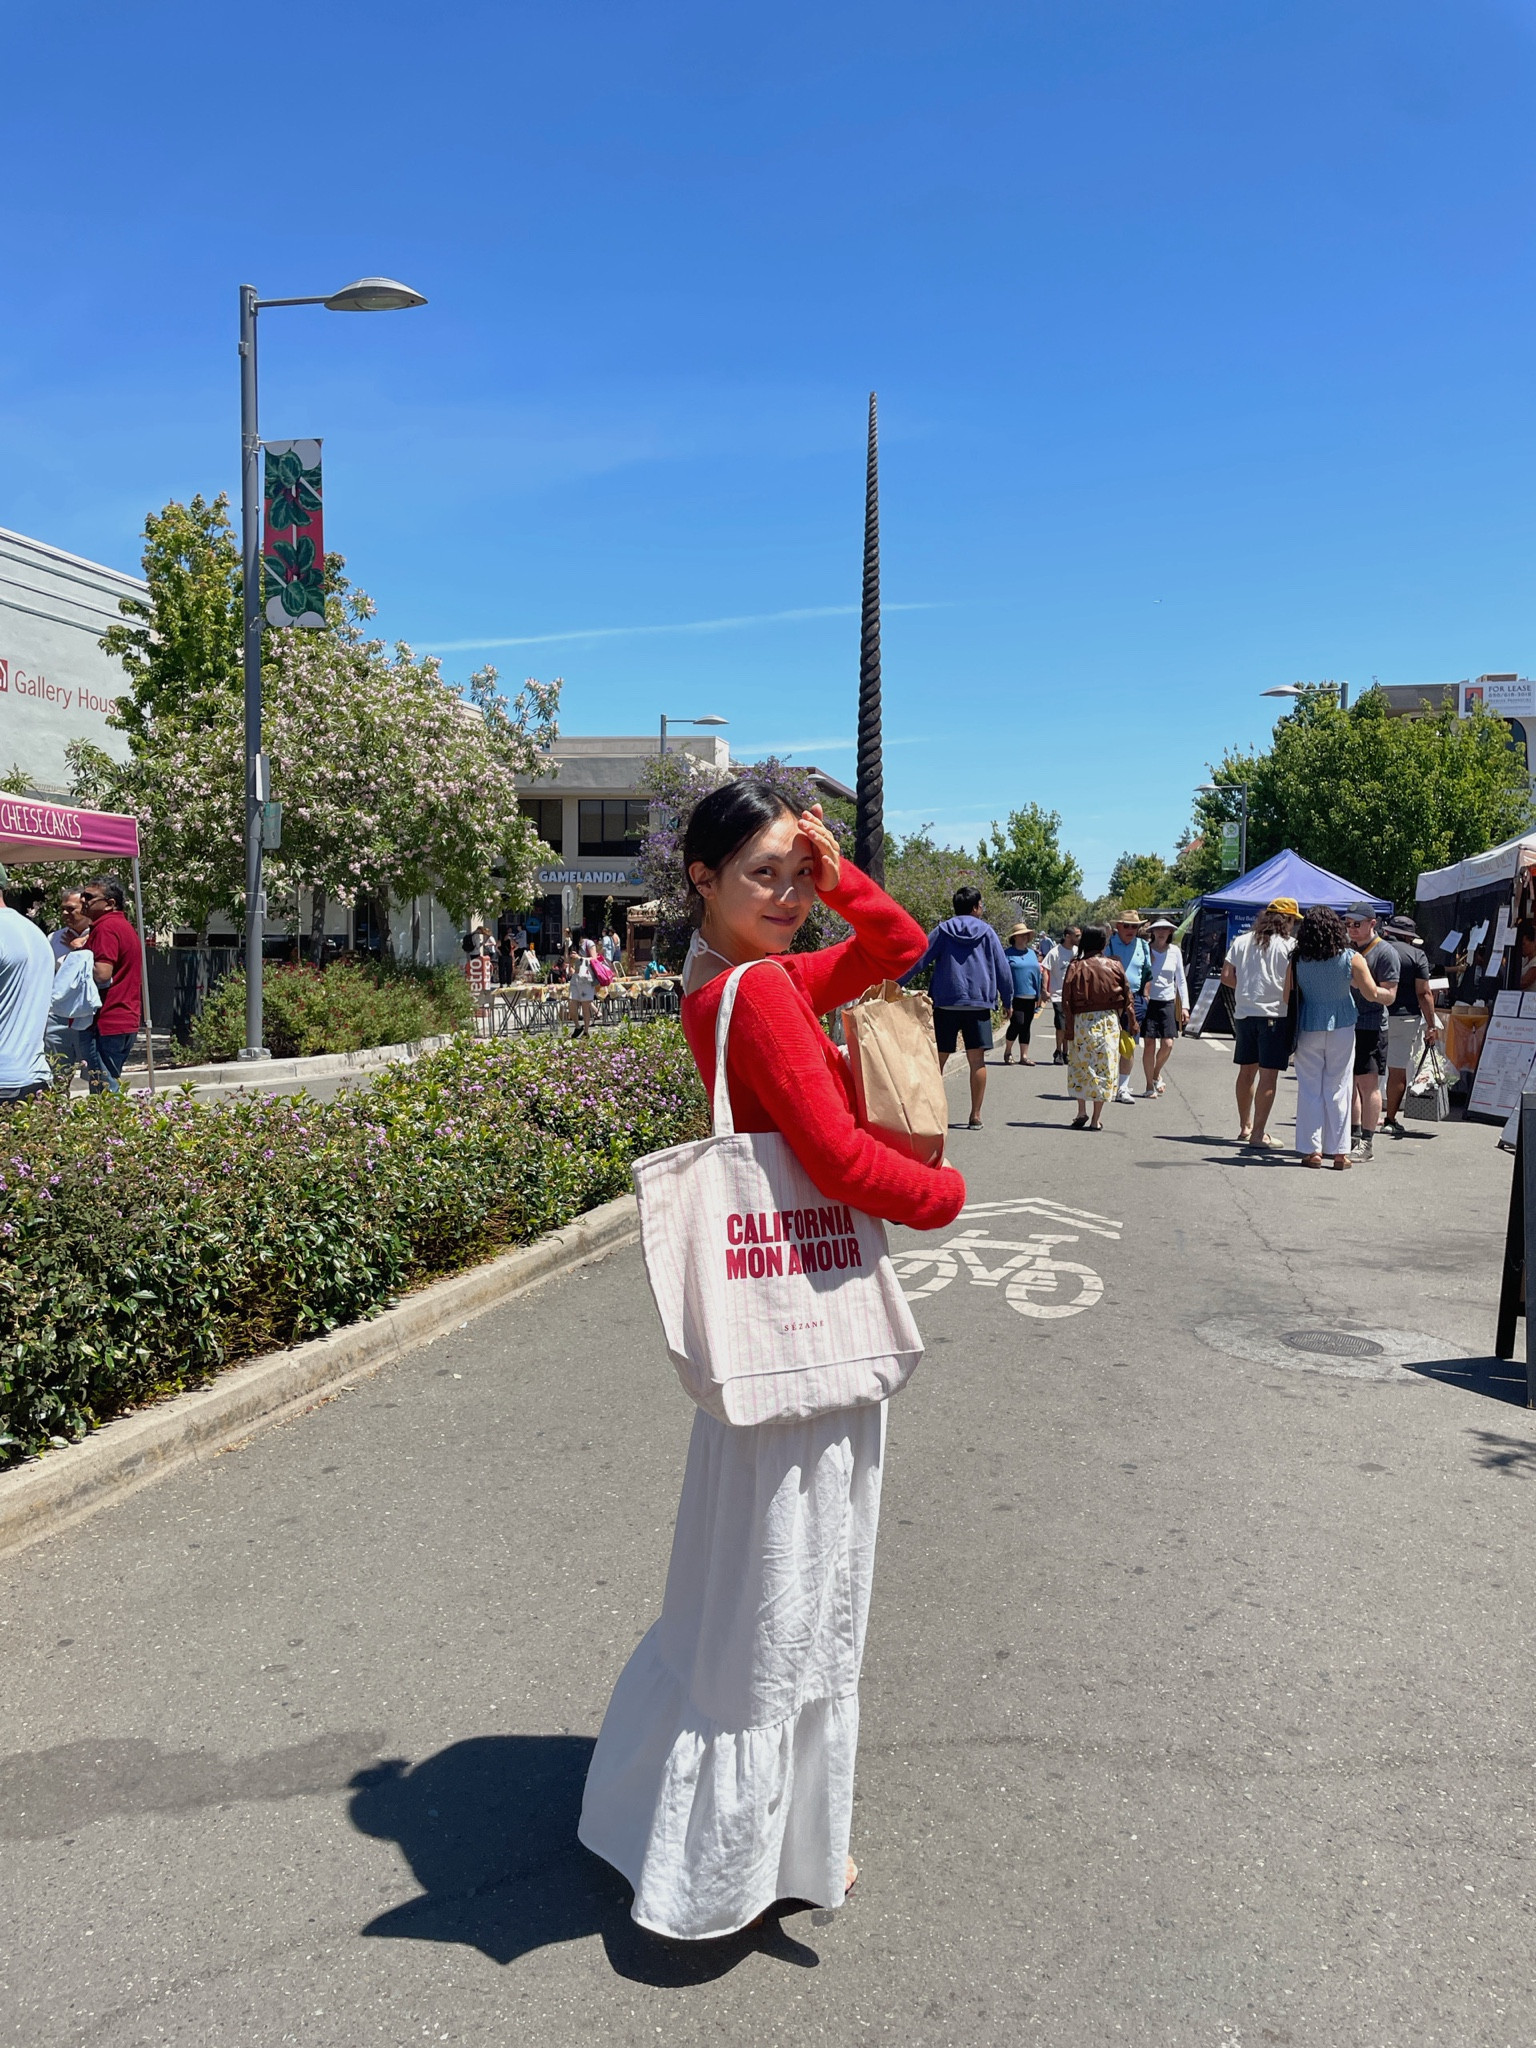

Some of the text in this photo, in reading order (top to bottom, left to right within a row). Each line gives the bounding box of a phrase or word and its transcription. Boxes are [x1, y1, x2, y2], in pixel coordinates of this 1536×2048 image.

[14, 670, 73, 710] Gallery
[1488, 684, 1532, 693] FOR LEASE
[0, 803, 82, 839] CHEESECAKES
[538, 870, 626, 883] GAMELANDIA
[726, 1204, 856, 1246] CALIFORNIA
[725, 1237, 862, 1281] MON AMOUR
[784, 1320, 825, 1332] SÉZANE
